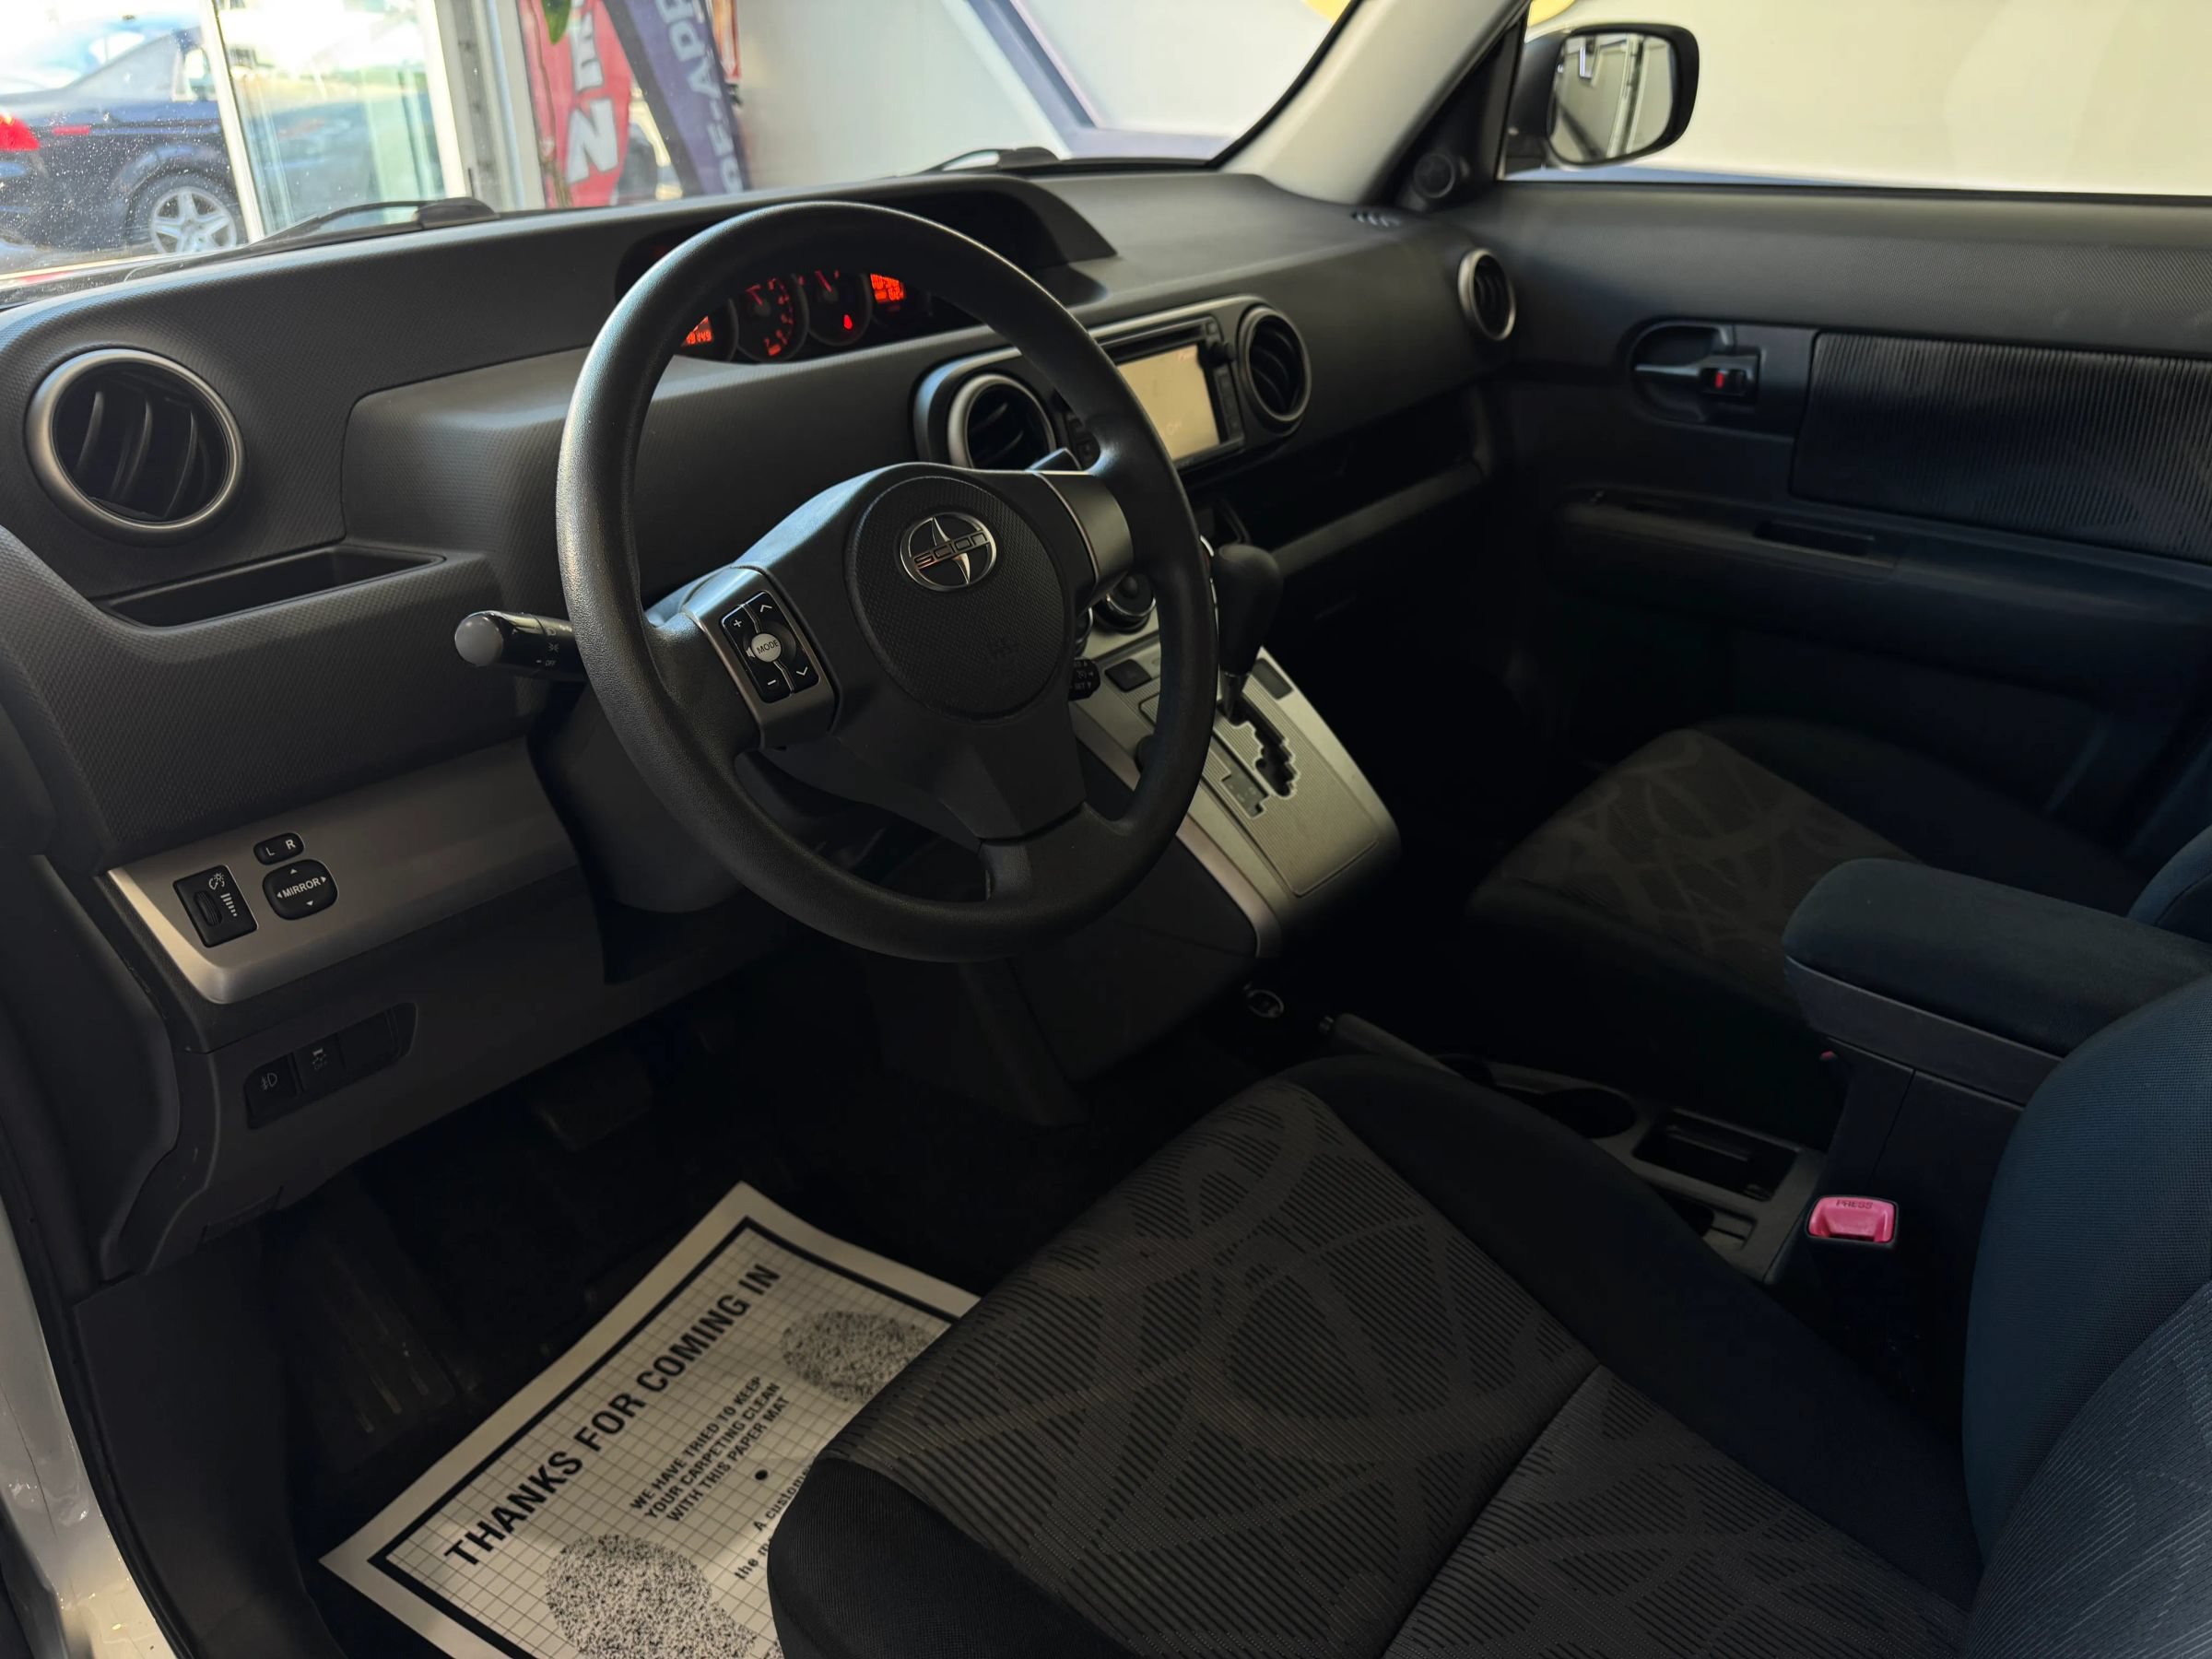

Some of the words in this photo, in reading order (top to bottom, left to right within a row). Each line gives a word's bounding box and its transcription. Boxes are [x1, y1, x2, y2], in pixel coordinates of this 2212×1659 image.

[566, 0, 618, 184] EN
[756, 640, 779, 654] MODE
[265, 846, 276, 856] L
[285, 839, 296, 850] R
[282, 877, 322, 899] MIRROR
[1835, 1199, 1873, 1209] PRESS
[443, 1450, 583, 1566] THANKS
[573, 1392, 645, 1453] FOR
[636, 1293, 752, 1393] COMING
[738, 1264, 782, 1297] IN
[630, 1489, 655, 1510] WE
[652, 1457, 688, 1490] HAVE
[682, 1422, 720, 1457] TRIED
[717, 1406, 736, 1422] TO
[734, 1376, 761, 1406] KEEP
[644, 1484, 684, 1520] YOUR
[681, 1419, 746, 1486] CARPETING
[743, 1382, 781, 1421] CLEAN
[666, 1489, 704, 1522] WITH
[699, 1461, 732, 1490] THIS
[727, 1422, 768, 1462] PAPER
[762, 1395, 790, 1422] MAT
[753, 1521, 767, 1532] A
[766, 1464, 812, 1519] custome
[734, 1558, 759, 1580] the
